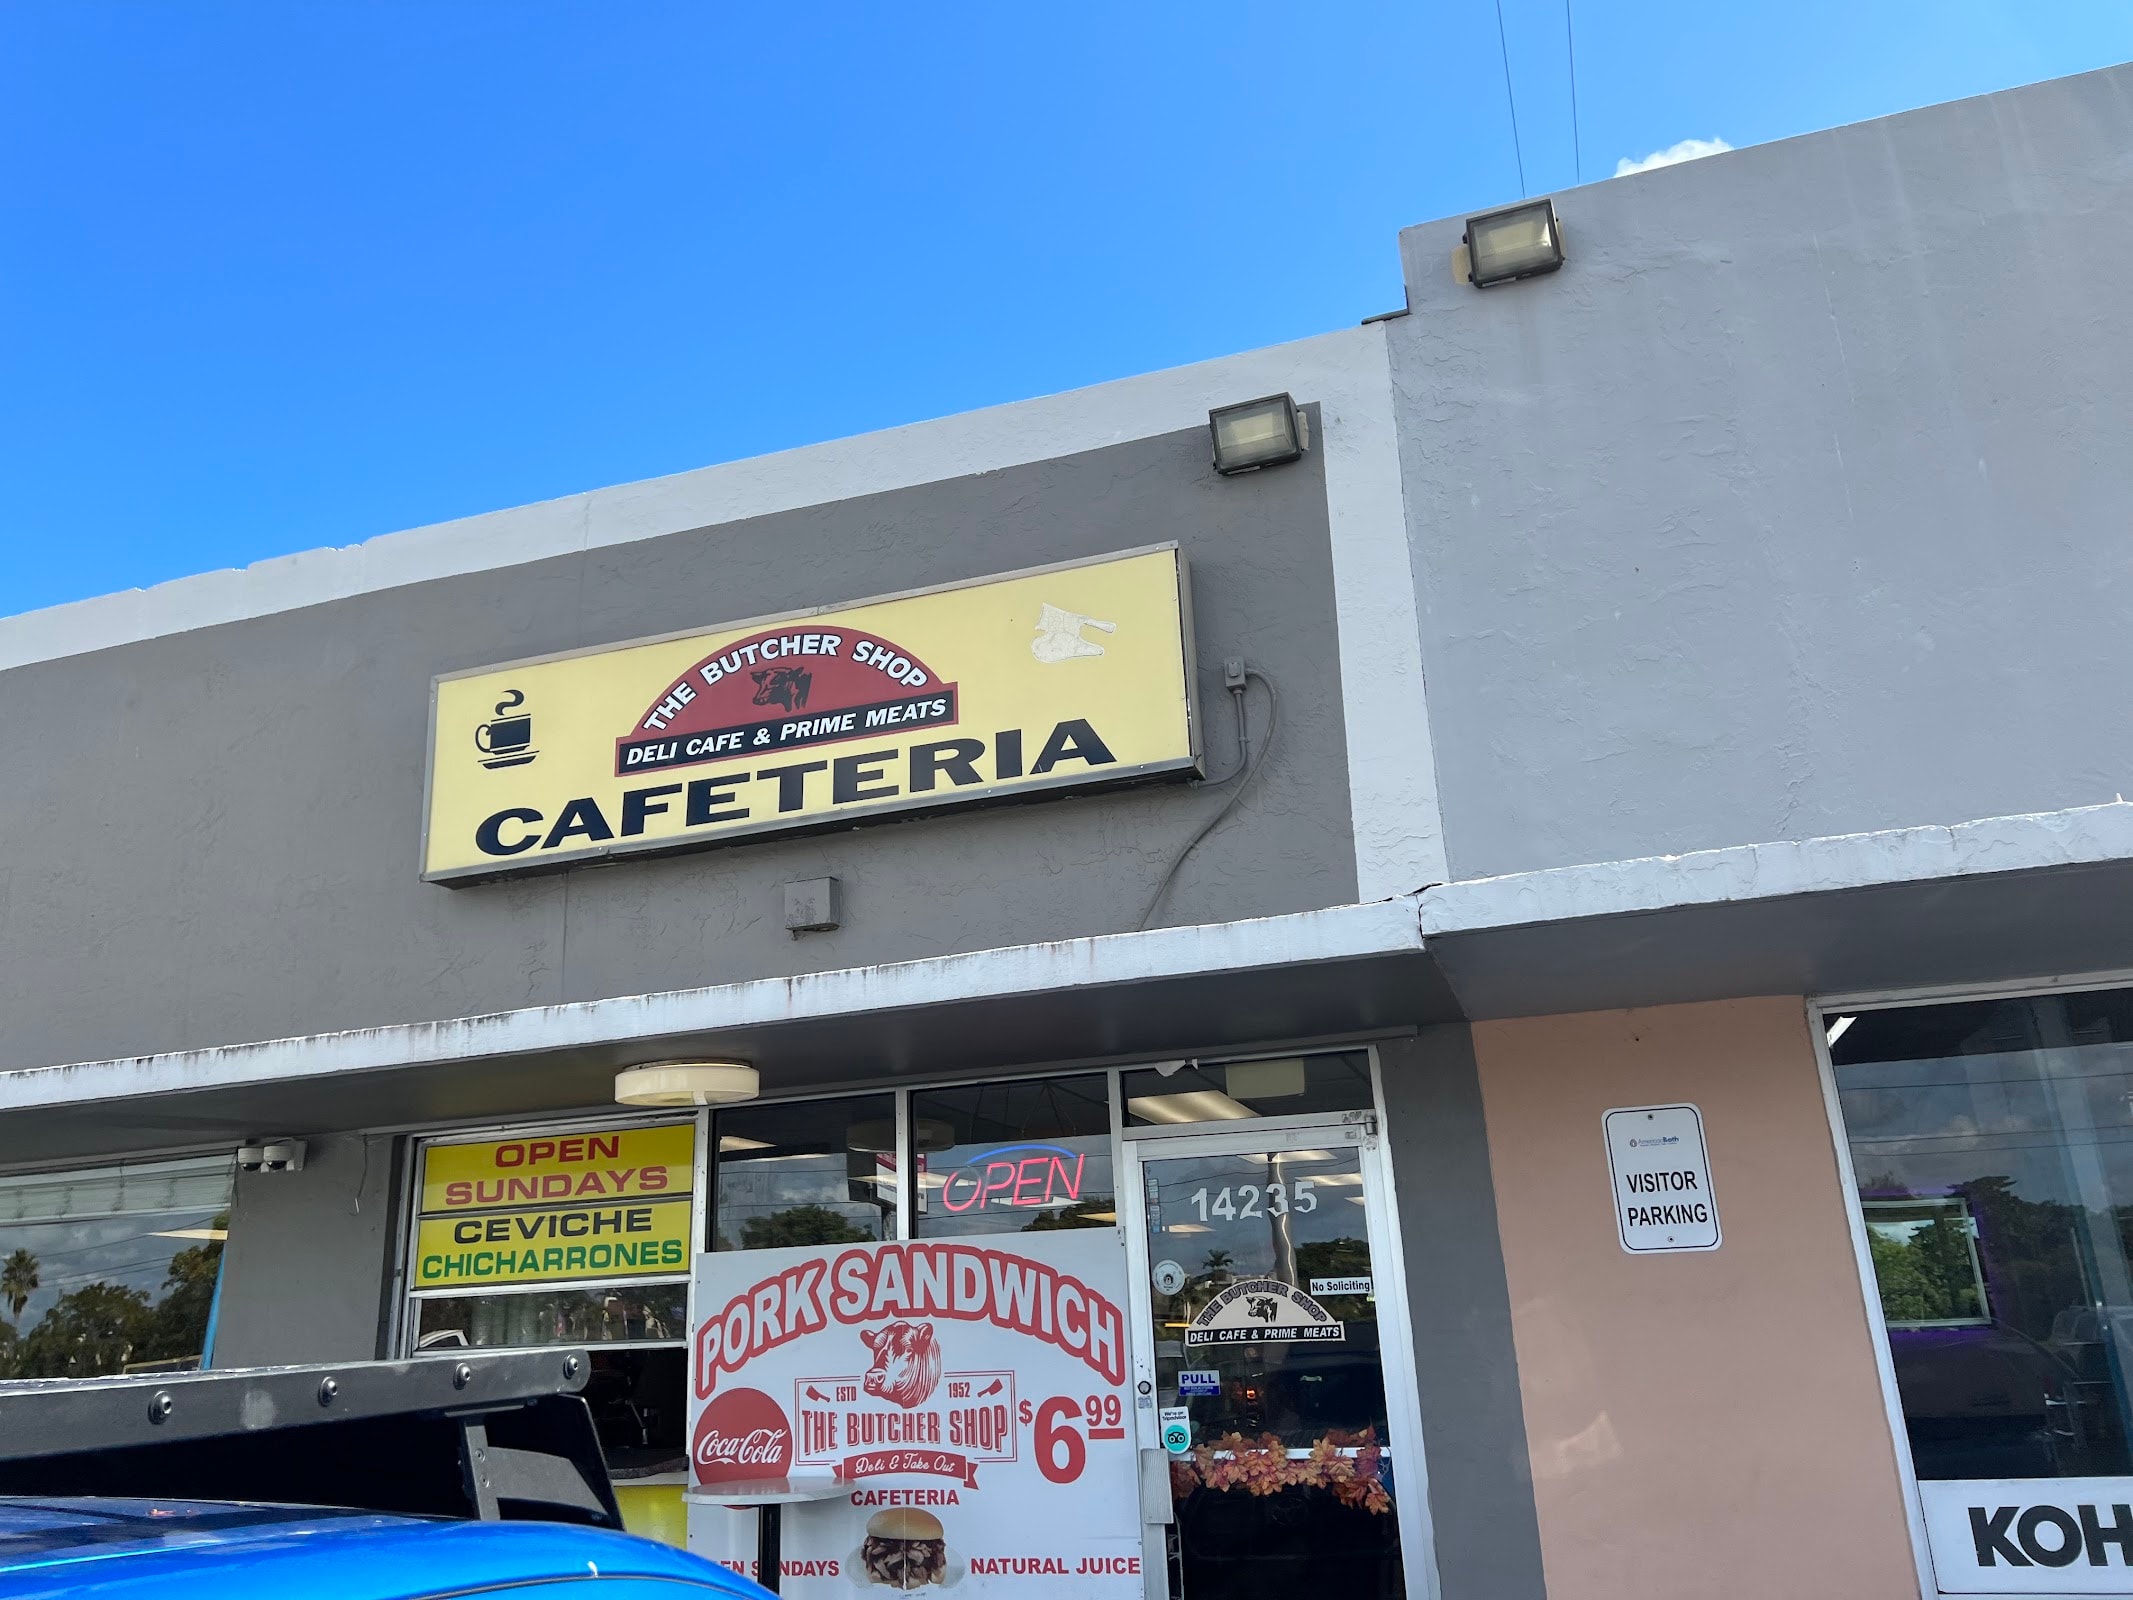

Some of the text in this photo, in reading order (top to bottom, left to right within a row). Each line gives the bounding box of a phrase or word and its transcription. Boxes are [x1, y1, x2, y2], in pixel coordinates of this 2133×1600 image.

[643, 633, 929, 733] THE BUTCHER SHOP
[626, 698, 948, 766] DELI CAFE & PRIME MEATS
[475, 718, 1117, 856] CAFETERIA
[495, 1135, 620, 1168] OPEN
[445, 1165, 668, 1205] SUNDAYS
[942, 1153, 1086, 1212] OPEN
[1626, 1170, 1698, 1194] VISITOR
[1190, 1181, 1318, 1222] 14235
[1627, 1203, 1709, 1227] PARKING
[454, 1207, 653, 1244] CEVICHE
[422, 1239, 683, 1279] CHICHARRONES
[1196, 1280, 1328, 1327] THE BUTCHER SHOP
[1311, 1279, 1370, 1293] No Soliciting
[698, 1244, 1125, 1396] PORK SANDWICH
[1189, 1326, 1341, 1343] DELI CAFE & PRIME MEATS
[836, 1382, 971, 1402] ESTD 1952
[1181, 1373, 1216, 1385] PULL
[696, 1427, 788, 1465] Coca-Cola
[801, 1405, 1008, 1456] THE BUTCHER SHOP
[855, 1453, 956, 1474] Deli & Take Out
[850, 1489, 960, 1506] CAFETERIA
[751, 1560, 840, 1577] SNDAYS
[970, 1557, 1141, 1575] NATURAL JUICE
